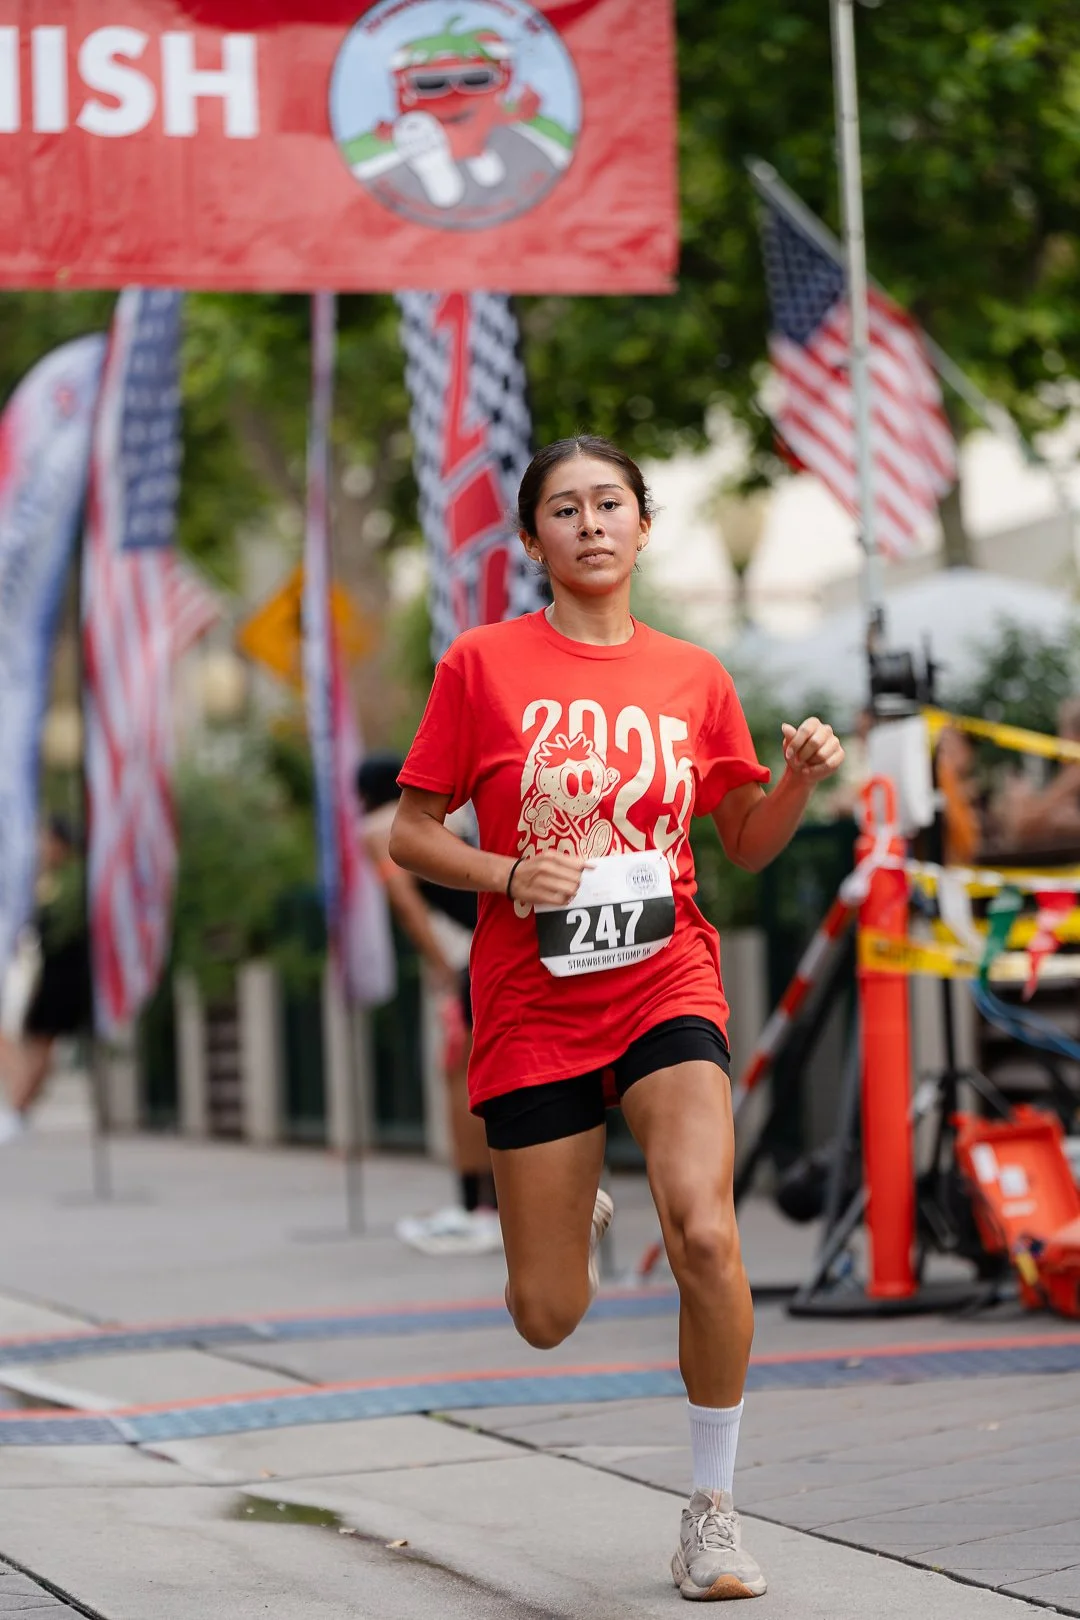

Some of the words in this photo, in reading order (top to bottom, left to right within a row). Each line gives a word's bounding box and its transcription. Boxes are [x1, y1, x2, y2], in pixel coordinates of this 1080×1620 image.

[0, 24, 260, 139] ISH
[519, 698, 693, 853] 2025
[566, 901, 643, 954] 247
[567, 954, 615, 970] STRAWBERRY
[617, 949, 640, 962] STOMP
[642, 947, 651, 956] 5K
